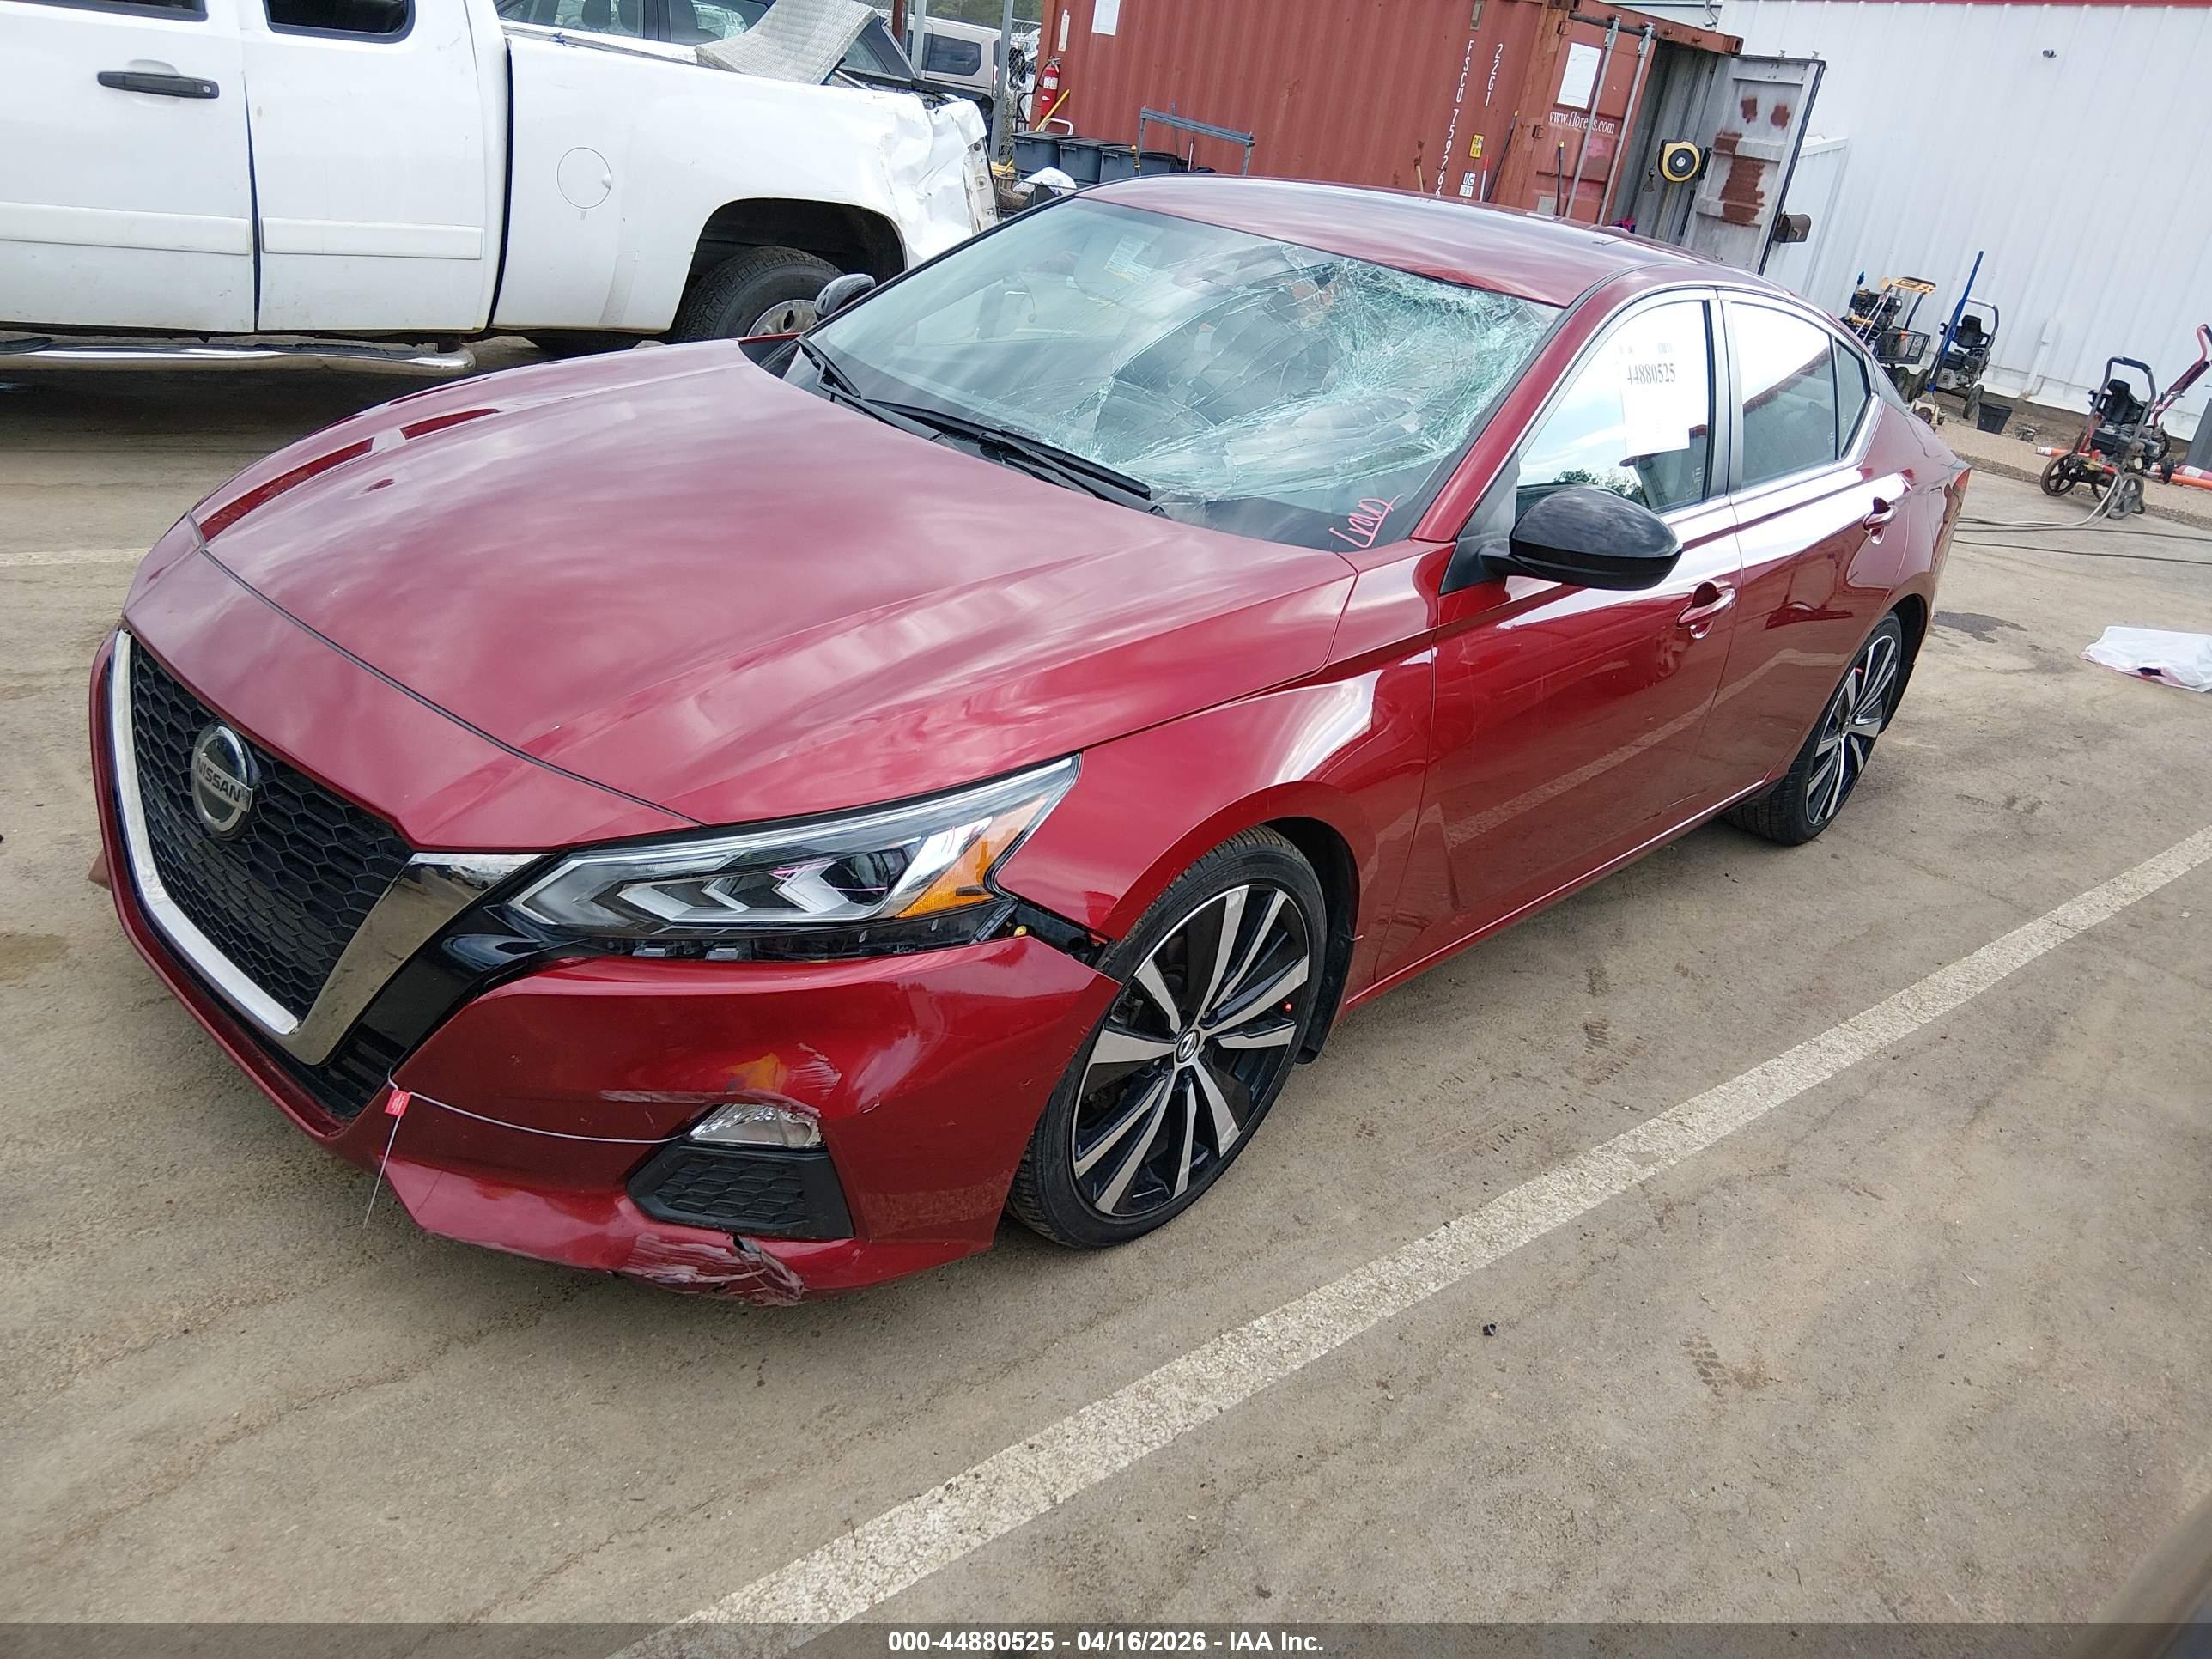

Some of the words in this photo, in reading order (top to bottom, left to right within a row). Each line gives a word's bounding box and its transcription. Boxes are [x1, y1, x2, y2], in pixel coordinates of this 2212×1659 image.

[1456, 40, 1474, 103] FSCU
[1485, 43, 1504, 107] 22G1
[1627, 363, 1676, 386] 44880525
[198, 757, 241, 803] NISSAN
